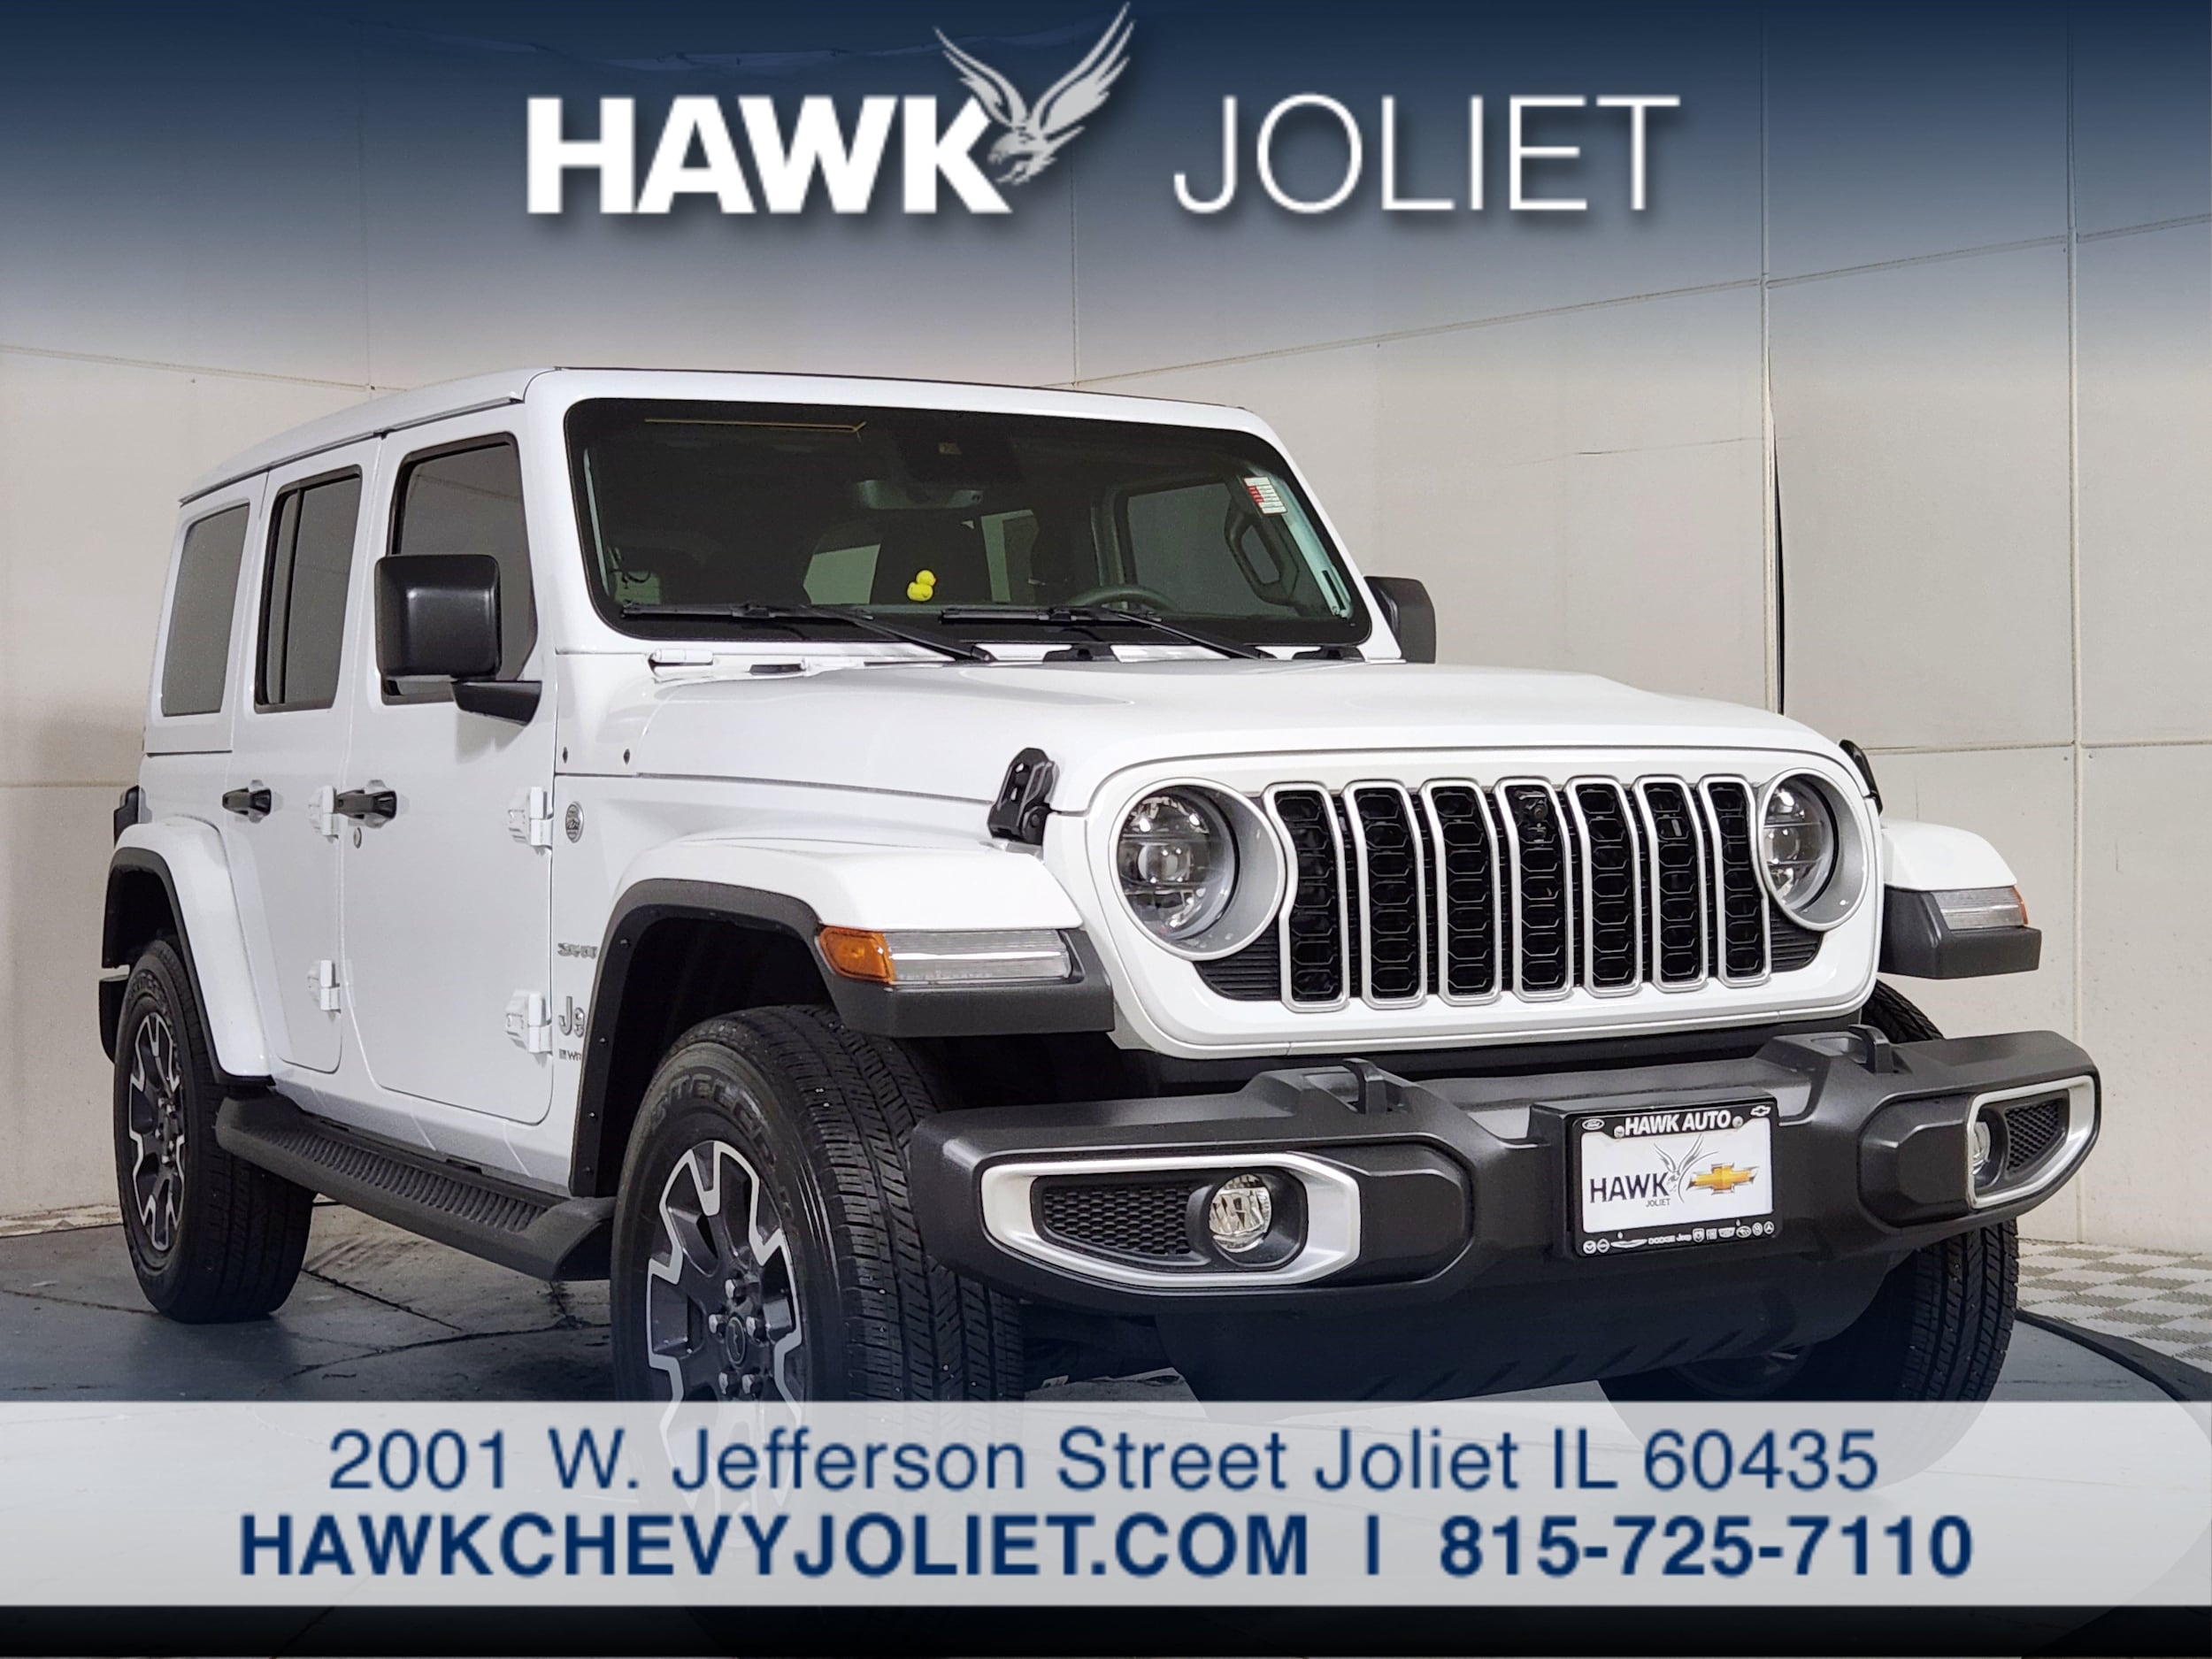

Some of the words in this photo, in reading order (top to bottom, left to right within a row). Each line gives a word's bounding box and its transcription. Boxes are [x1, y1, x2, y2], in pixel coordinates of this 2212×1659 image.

[1624, 1114, 1680, 1136] HAWK
[1681, 1110, 1732, 1132] AUTO
[1590, 1171, 1670, 1204] HAWK
[1646, 1198, 1671, 1208] JOLIET
